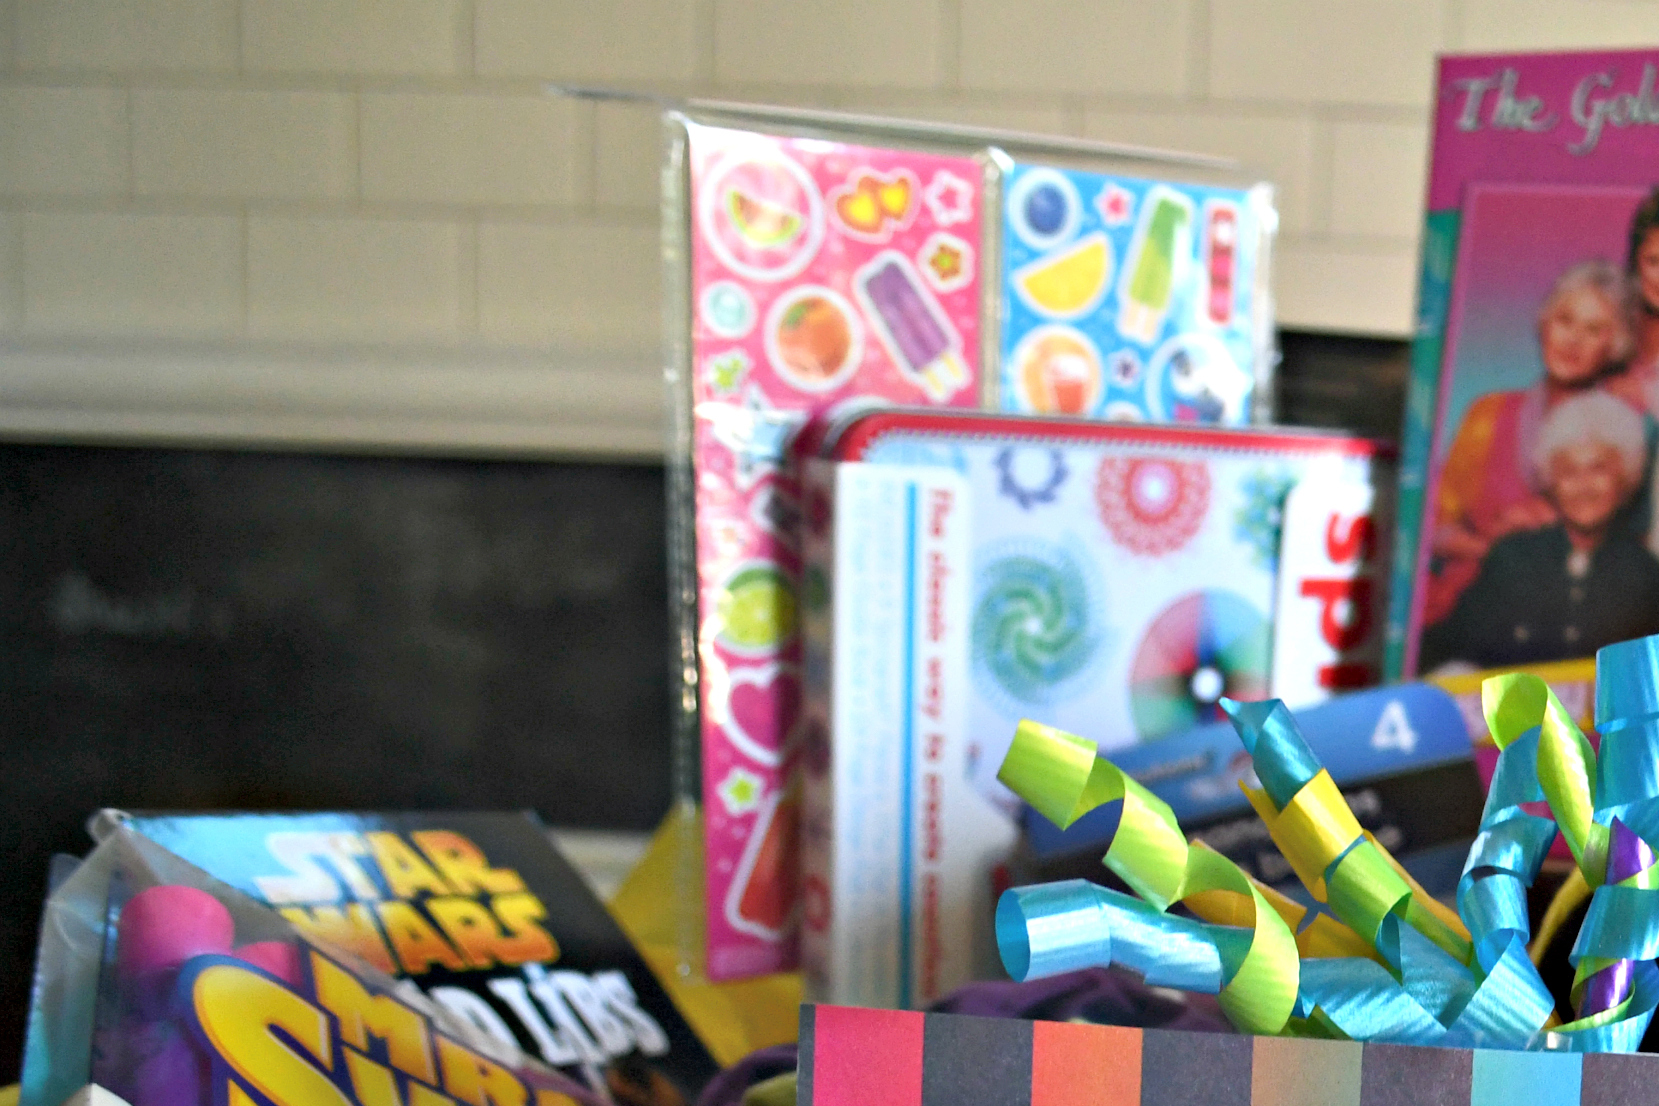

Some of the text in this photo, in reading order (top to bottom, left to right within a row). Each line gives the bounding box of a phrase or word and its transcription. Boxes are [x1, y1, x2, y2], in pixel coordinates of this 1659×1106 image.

[1445, 67, 1558, 132] The
[1370, 701, 1418, 756] 4
[252, 829, 527, 907] STAR
[276, 888, 560, 974] WARS
